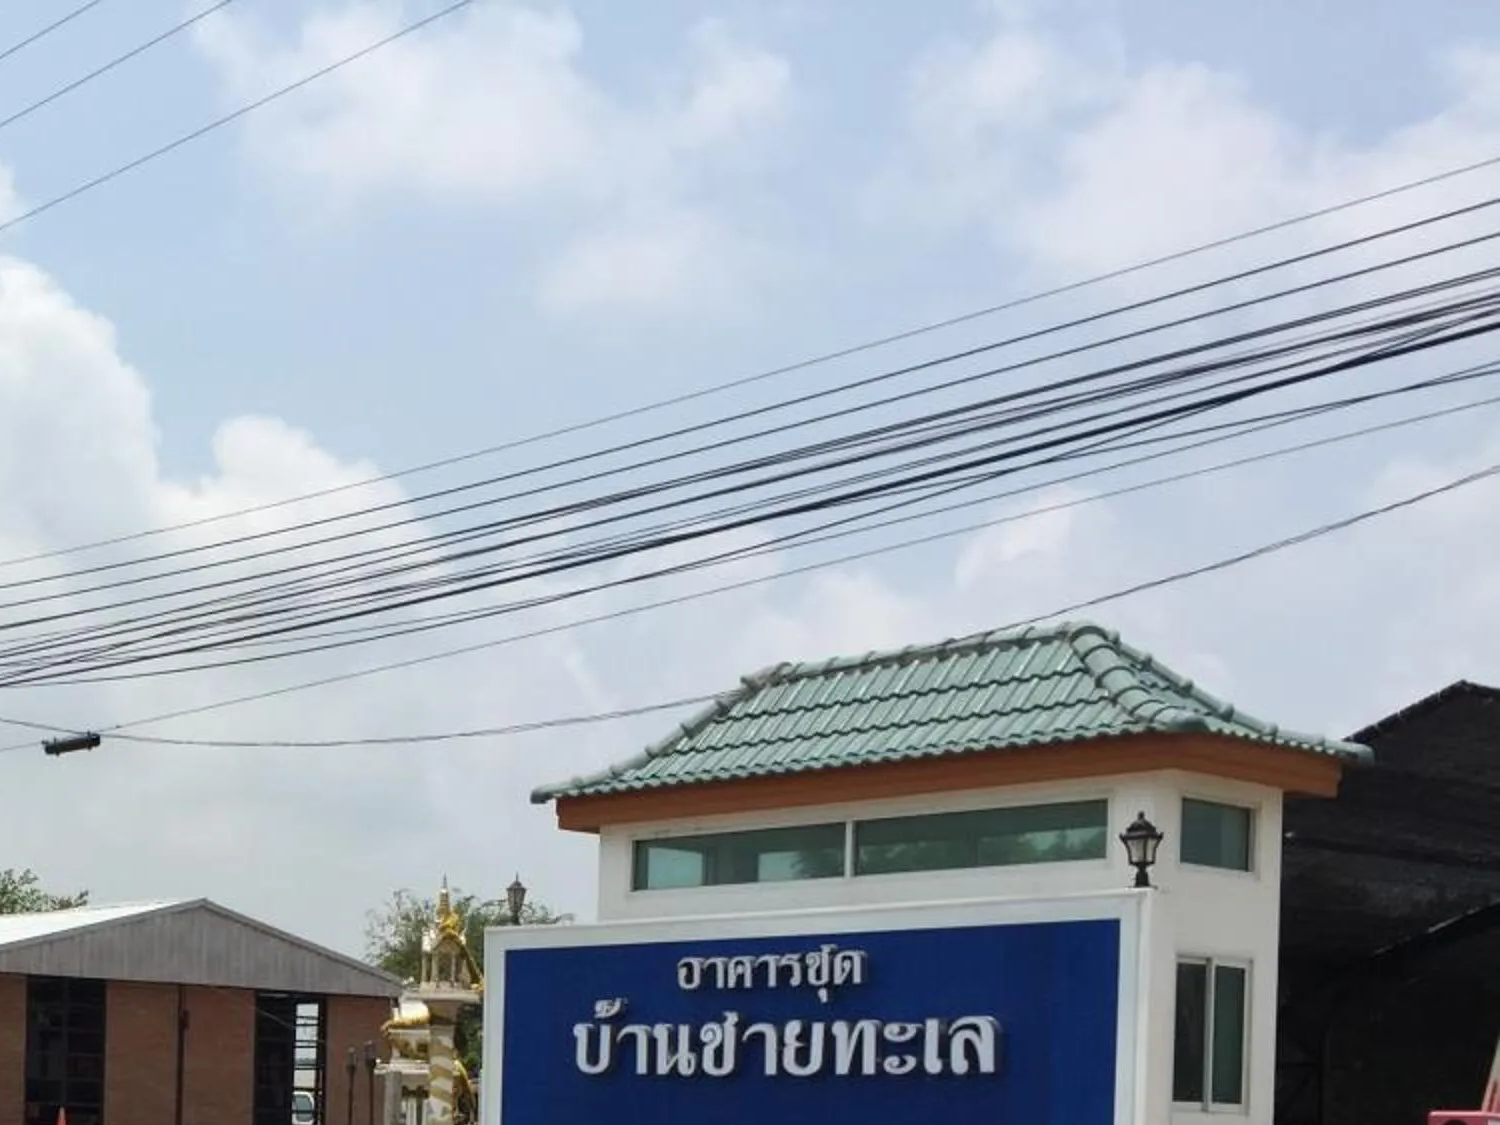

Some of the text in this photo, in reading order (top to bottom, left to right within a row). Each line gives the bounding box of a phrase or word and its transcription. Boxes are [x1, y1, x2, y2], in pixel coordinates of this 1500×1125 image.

[677, 943, 867, 1003] อาคารชุด
[573, 997, 998, 1076] บ้านชายทะเล
